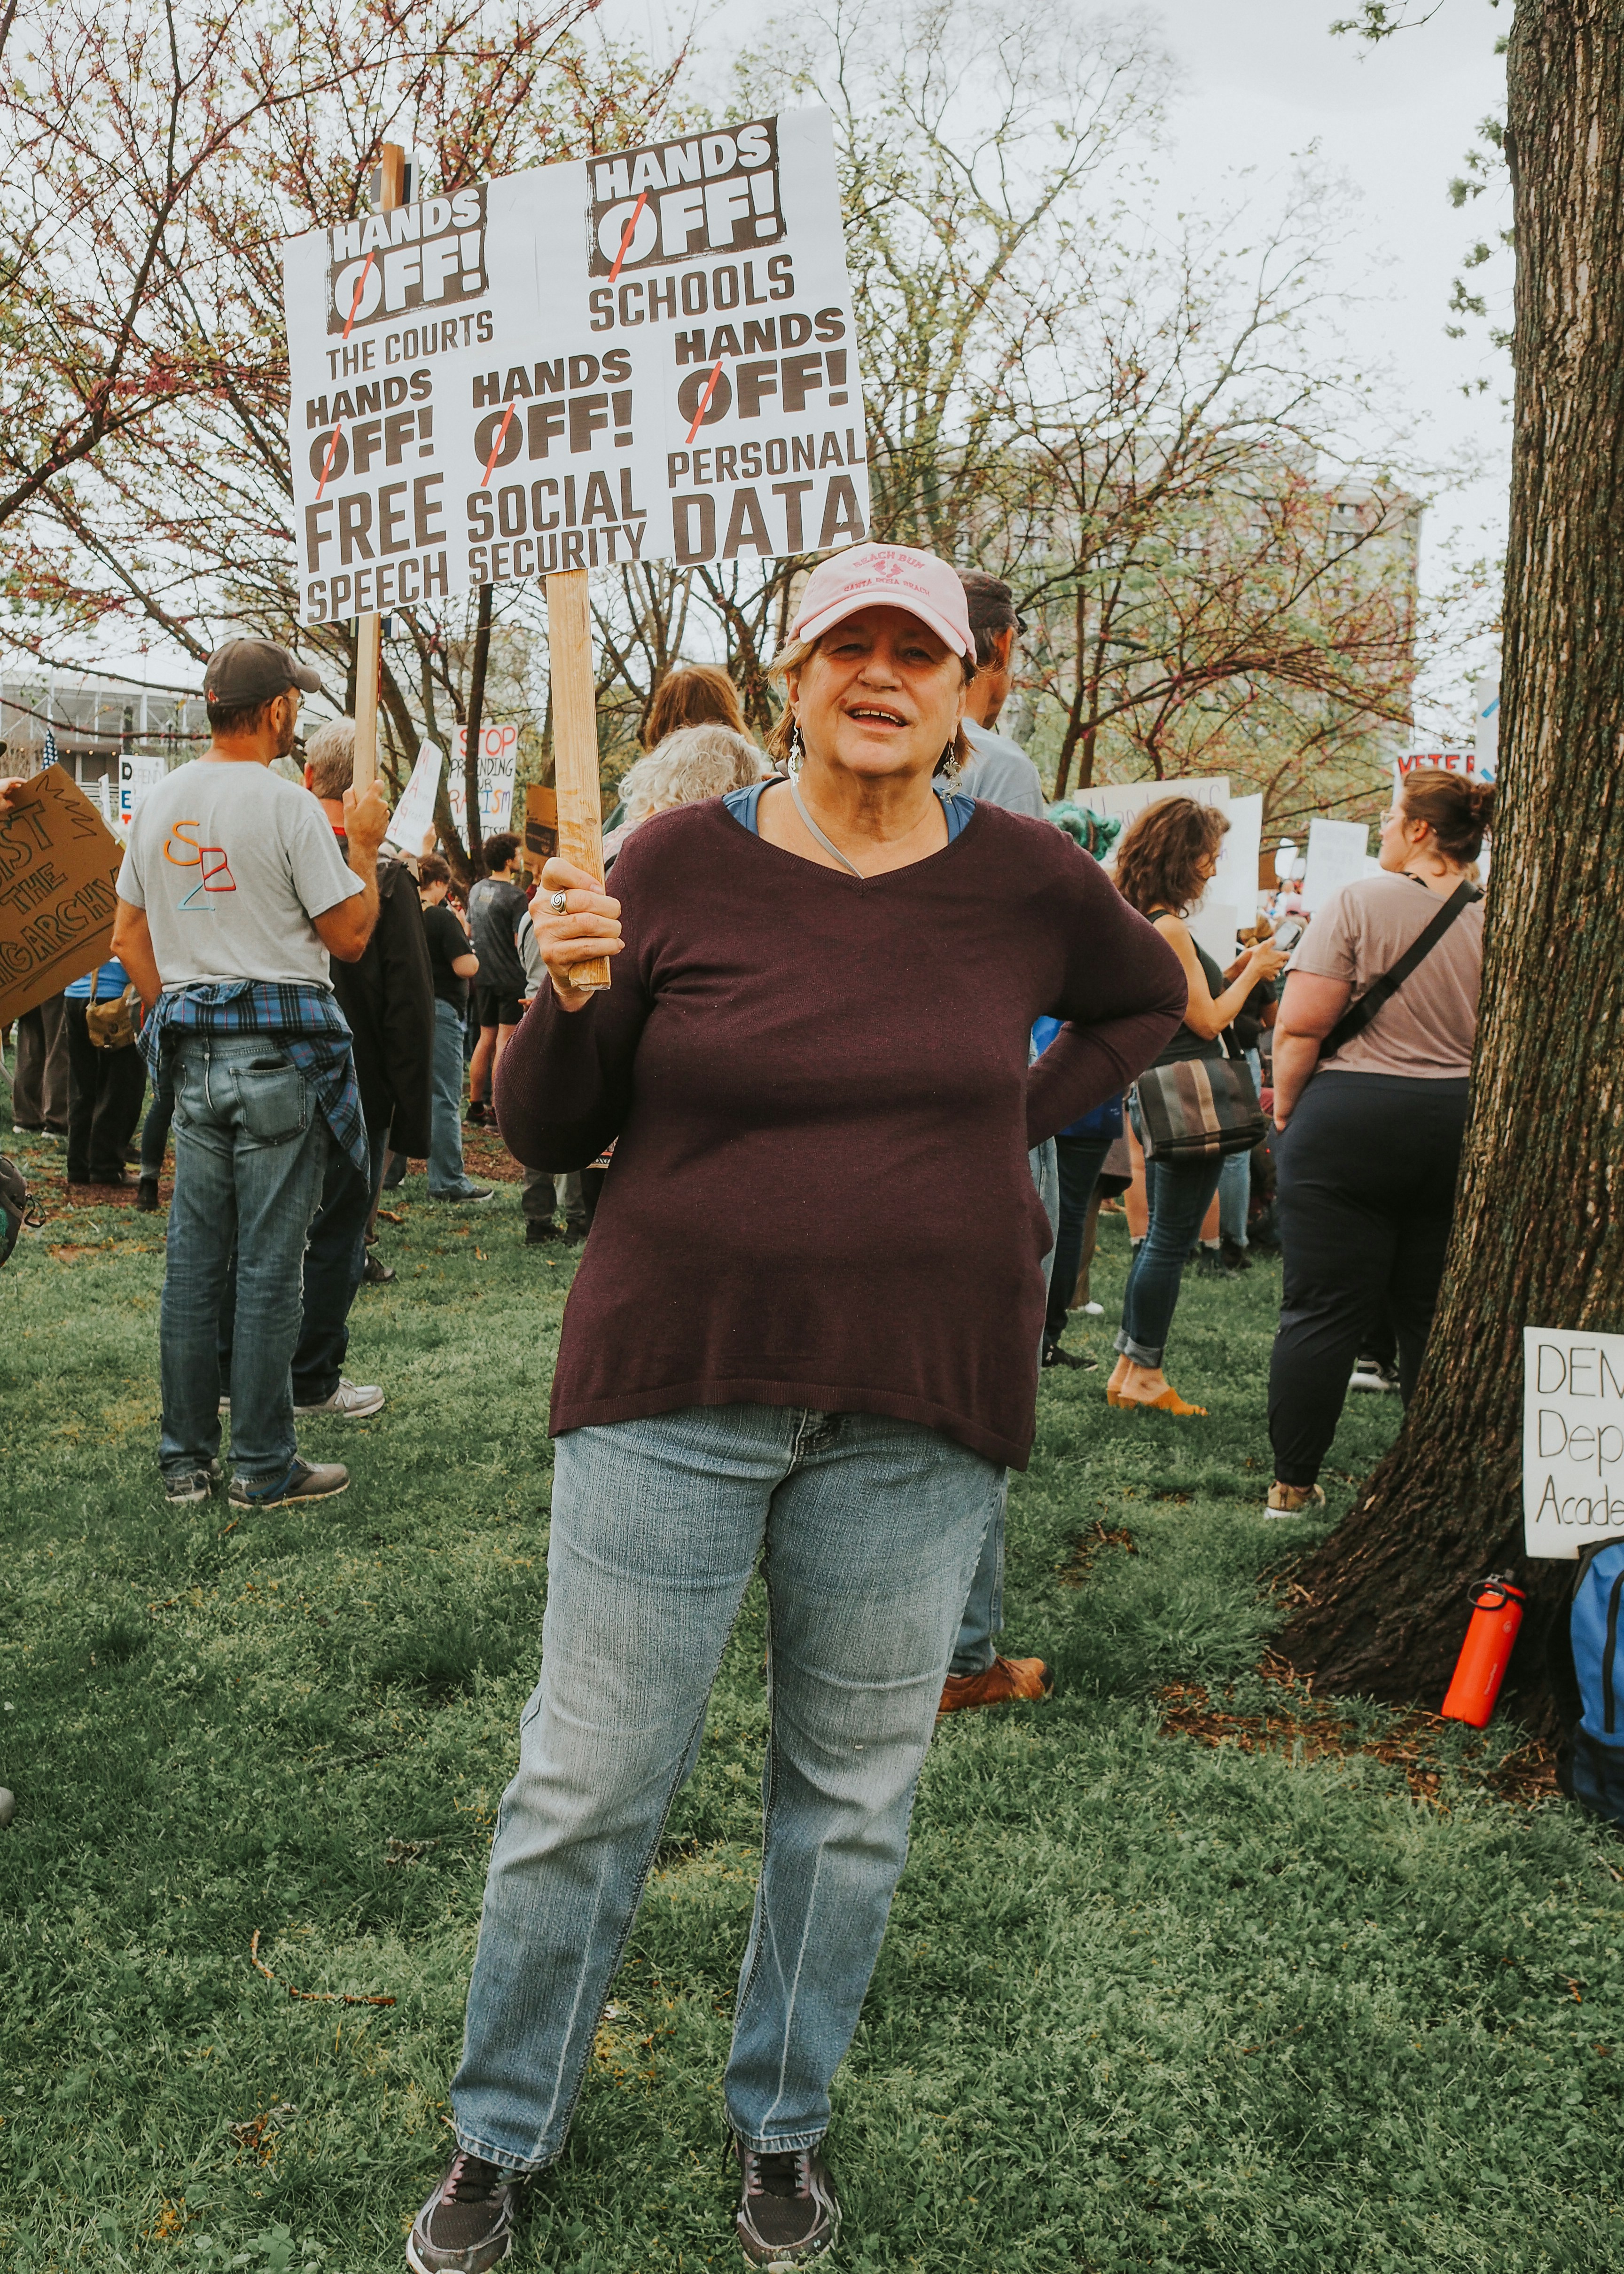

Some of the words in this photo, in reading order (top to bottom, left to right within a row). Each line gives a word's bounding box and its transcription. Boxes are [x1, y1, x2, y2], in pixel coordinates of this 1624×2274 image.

[595, 125, 771, 202] HANDS
[332, 188, 481, 263] HANDS
[598, 170, 778, 265] OFF!
[335, 230, 481, 322] OFF!
[589, 254, 794, 331] SCHOOLS
[326, 340, 375, 380] THE
[386, 311, 492, 365] COURTS
[675, 307, 845, 365] HANDS
[306, 369, 432, 429] HANDS
[473, 348, 632, 408] HANDS
[678, 349, 848, 425] OFF!
[309, 405, 434, 483] OFF!
[474, 390, 633, 468] OFF!
[667, 428, 865, 488] PERSONAL
[305, 472, 446, 573] FREE
[467, 467, 647, 543] SOCIAL
[672, 474, 866, 565] DATA
[307, 551, 449, 624] SPEECH
[468, 521, 647, 584] SECURITY
[853, 551, 895, 568] BEACH
[897, 553, 925, 569] BUM
[460, 726, 516, 757] SOP
[0, 862, 68, 915] THE
